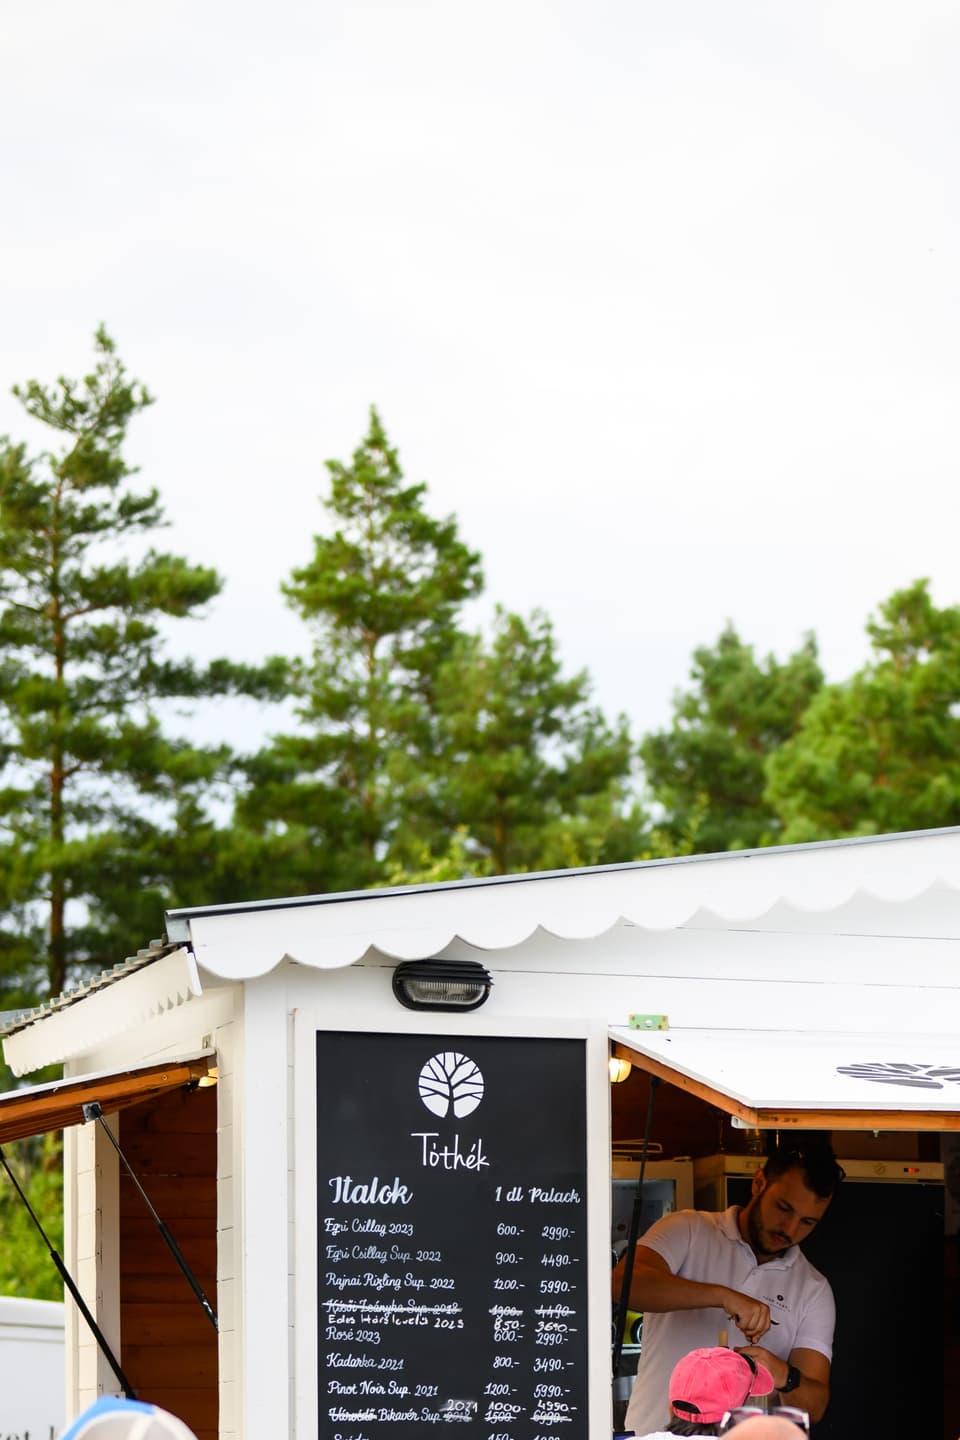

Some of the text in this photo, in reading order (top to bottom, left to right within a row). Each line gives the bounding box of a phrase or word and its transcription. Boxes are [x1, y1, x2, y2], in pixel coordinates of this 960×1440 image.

[411, 1133, 490, 1171] Tóthék
[329, 1176, 413, 1204] Italok
[496, 1186, 580, 1203] 1 dl Palack
[324, 1218, 413, 1237] Egri Csillag 2023
[326, 1245, 349, 1262] Egri
[352, 1245, 387, 1264] Csillag
[416, 1250, 441, 1261] 2022
[326, 1272, 362, 1290] Rajnai
[430, 1278, 455, 1289] 2022
[326, 1326, 380, 1344] Rosé 2023
[326, 1352, 404, 1370] Kadarka 2021
[327, 1381, 357, 1394] Pinot
[360, 1380, 386, 1394] Noir
[414, 1385, 438, 1397] 2021
[376, 1406, 420, 1423] Bikavér
